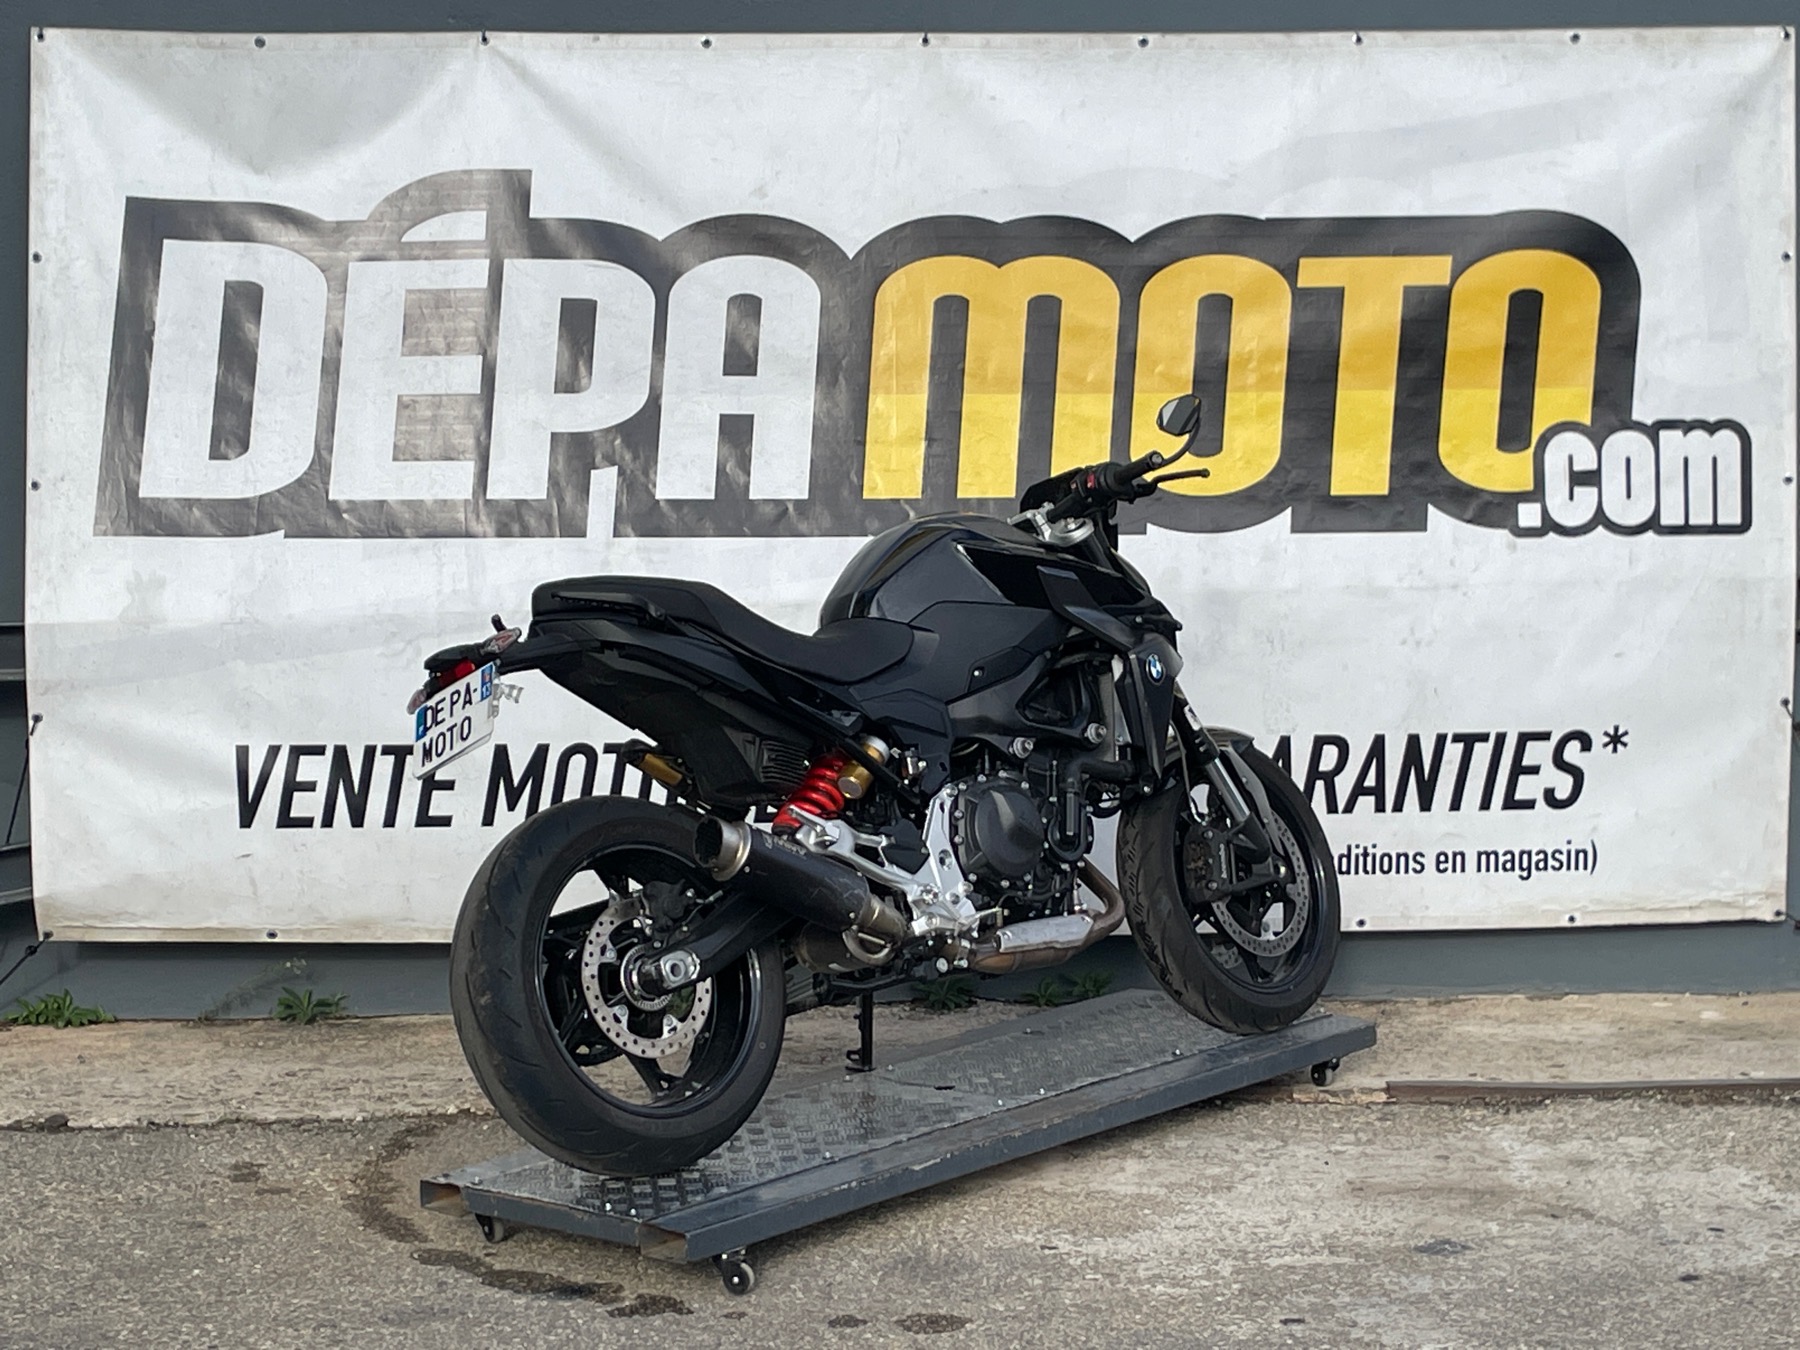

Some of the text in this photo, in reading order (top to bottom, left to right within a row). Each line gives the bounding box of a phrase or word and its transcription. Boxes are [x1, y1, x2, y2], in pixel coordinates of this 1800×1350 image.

[482, 682, 493, 699] 13
[421, 715, 472, 768] MOTO
[235, 743, 456, 829] VENTE
[481, 742, 684, 828] MOT
[1334, 839, 1598, 881] ditions en magasin)
